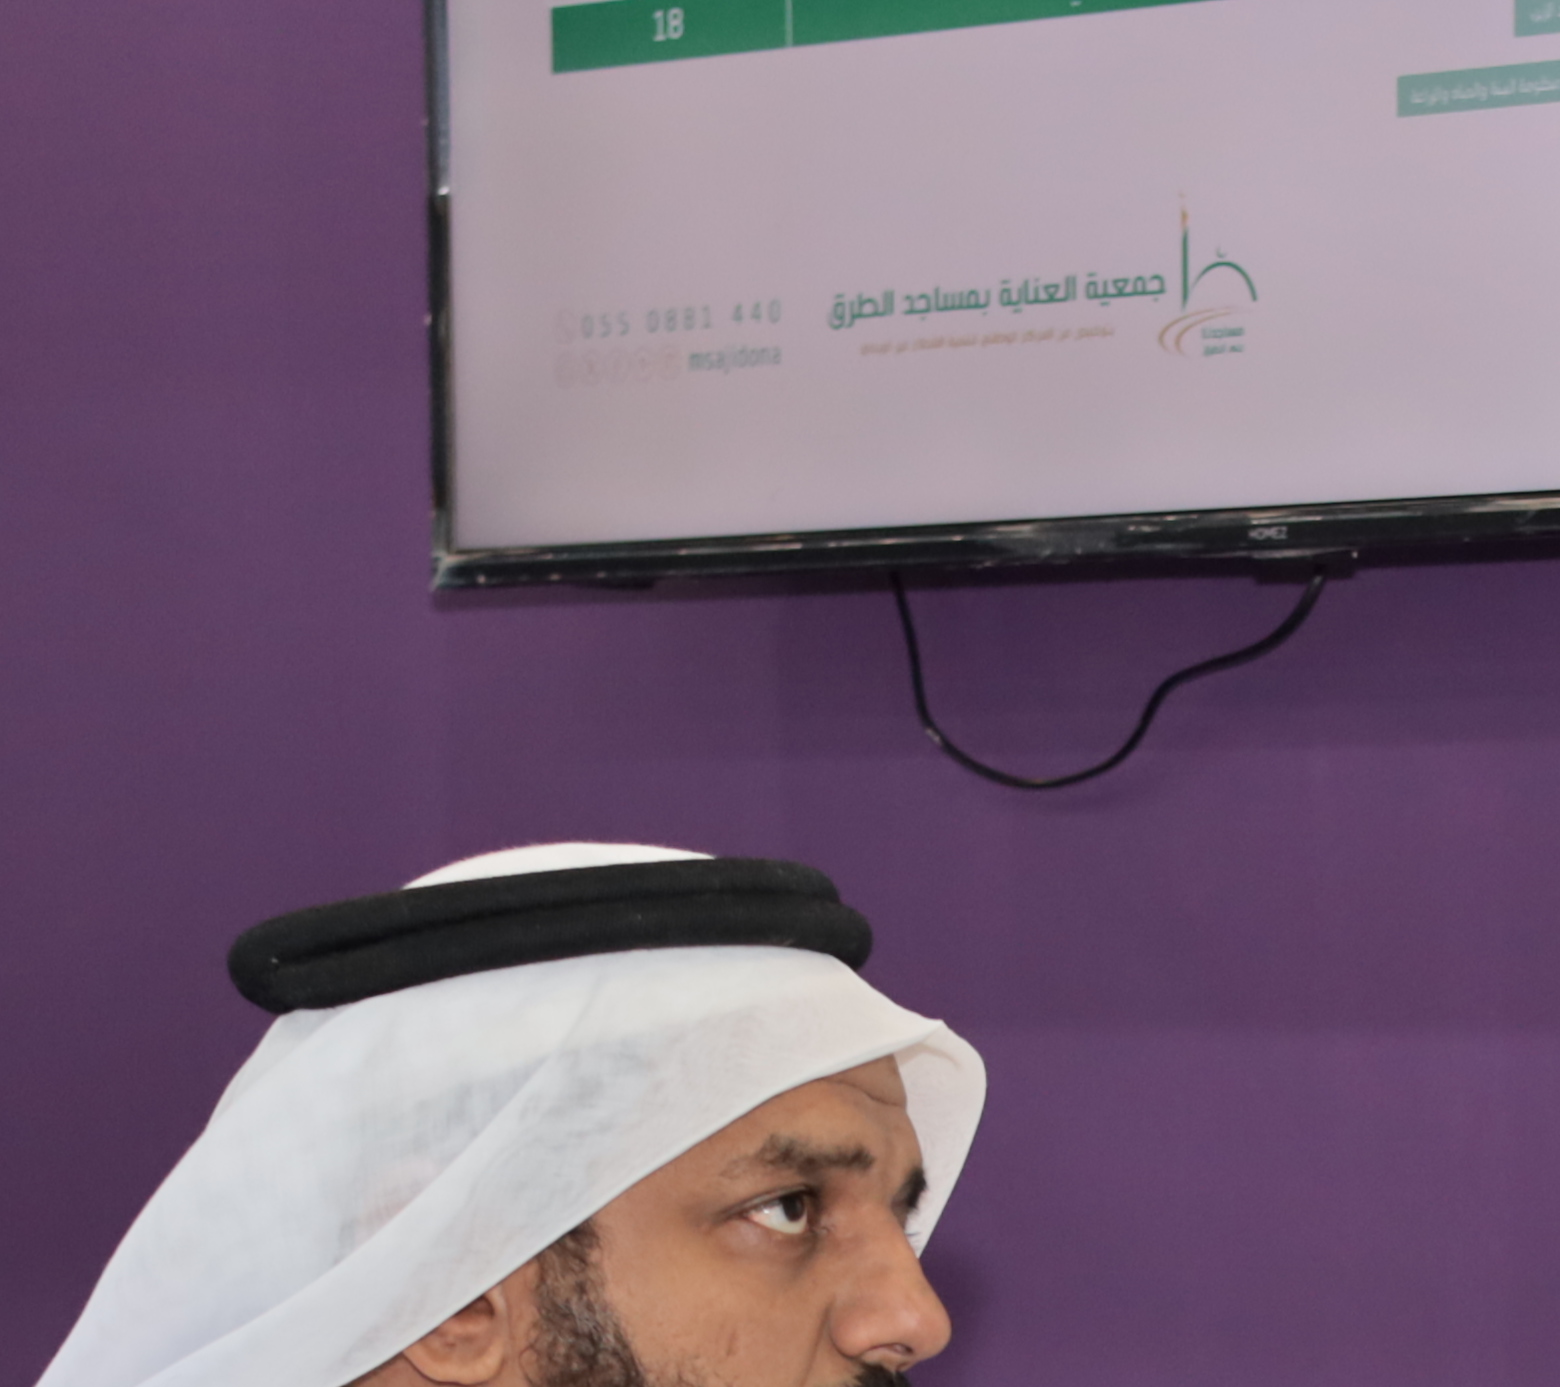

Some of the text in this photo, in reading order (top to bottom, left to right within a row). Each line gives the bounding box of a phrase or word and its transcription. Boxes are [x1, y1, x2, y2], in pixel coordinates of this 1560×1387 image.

[651, 8, 685, 41] 18
[828, 270, 1167, 330] جمعية العناية بمساجد الطرق
